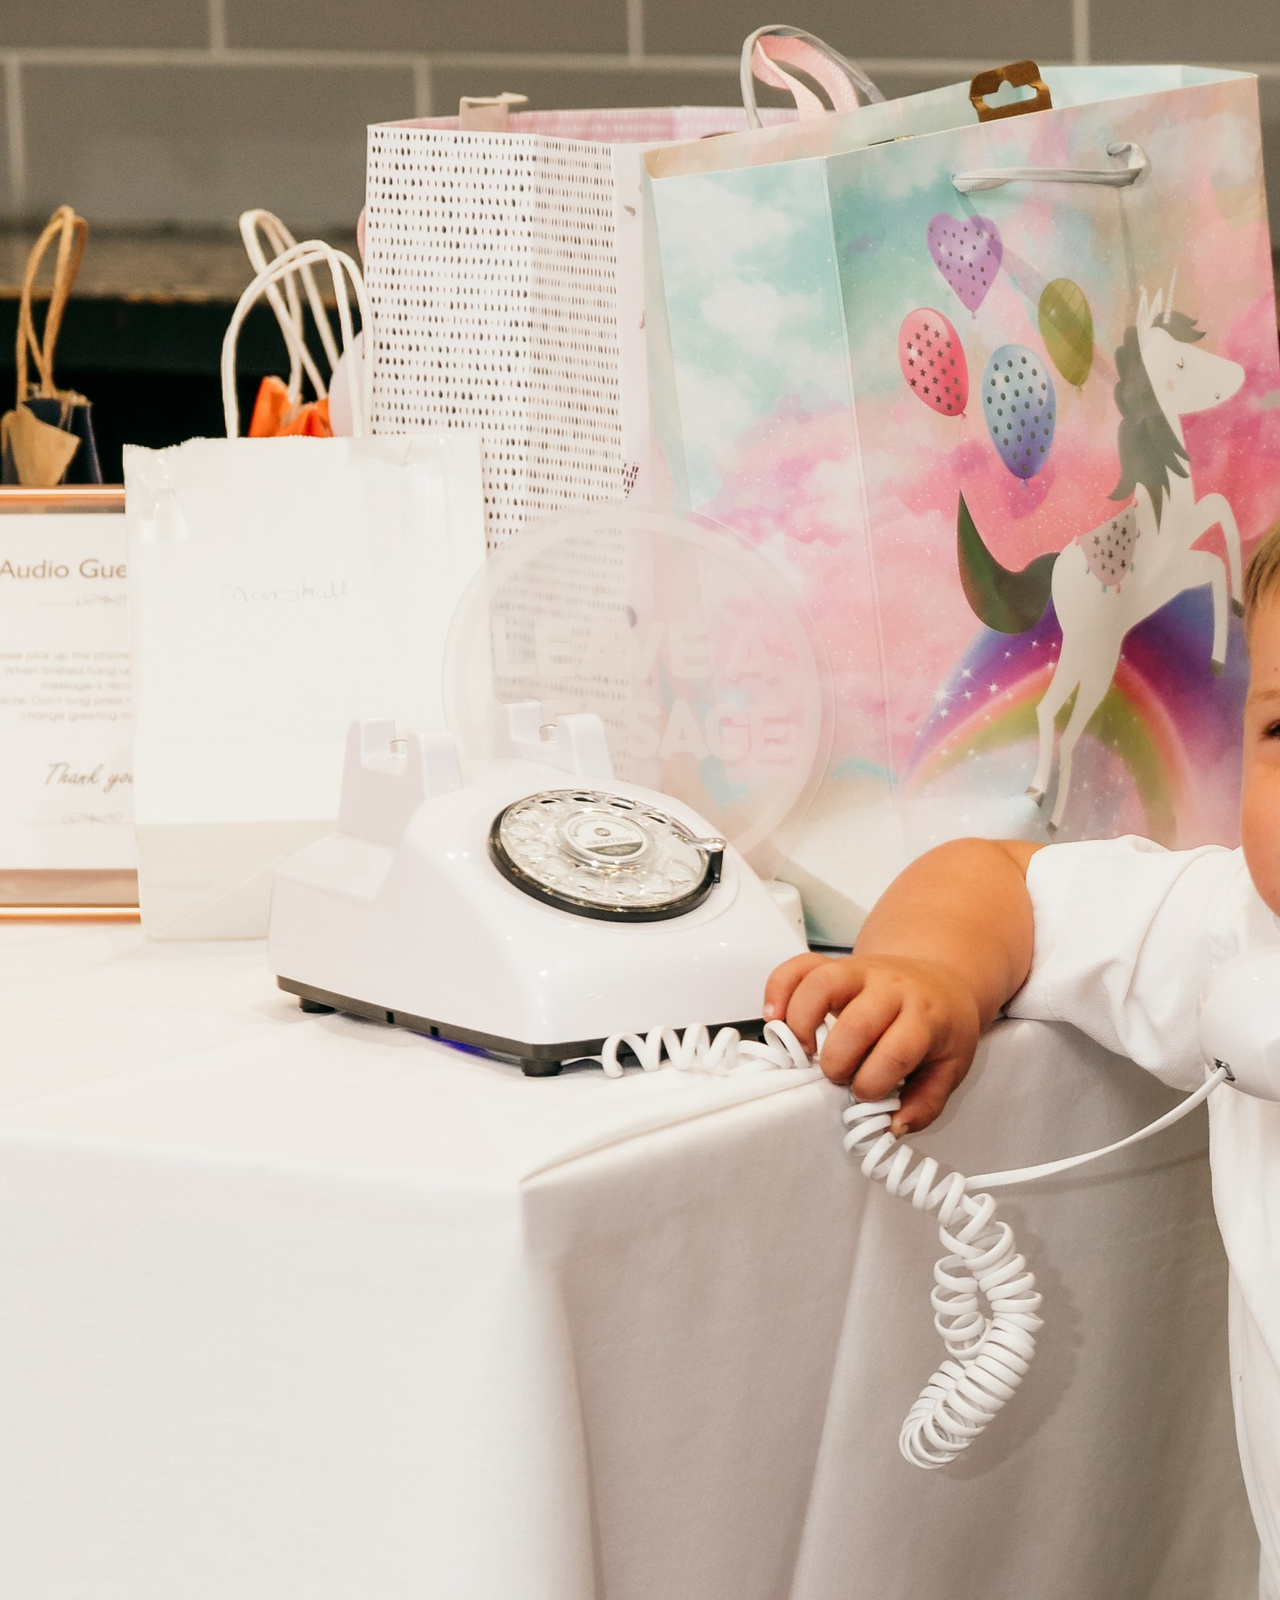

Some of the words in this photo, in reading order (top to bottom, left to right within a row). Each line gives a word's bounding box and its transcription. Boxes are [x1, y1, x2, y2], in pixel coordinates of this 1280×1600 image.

[0, 558, 70, 579] Audio
[725, 618, 779, 681] A
[45, 761, 105, 787] Thank
